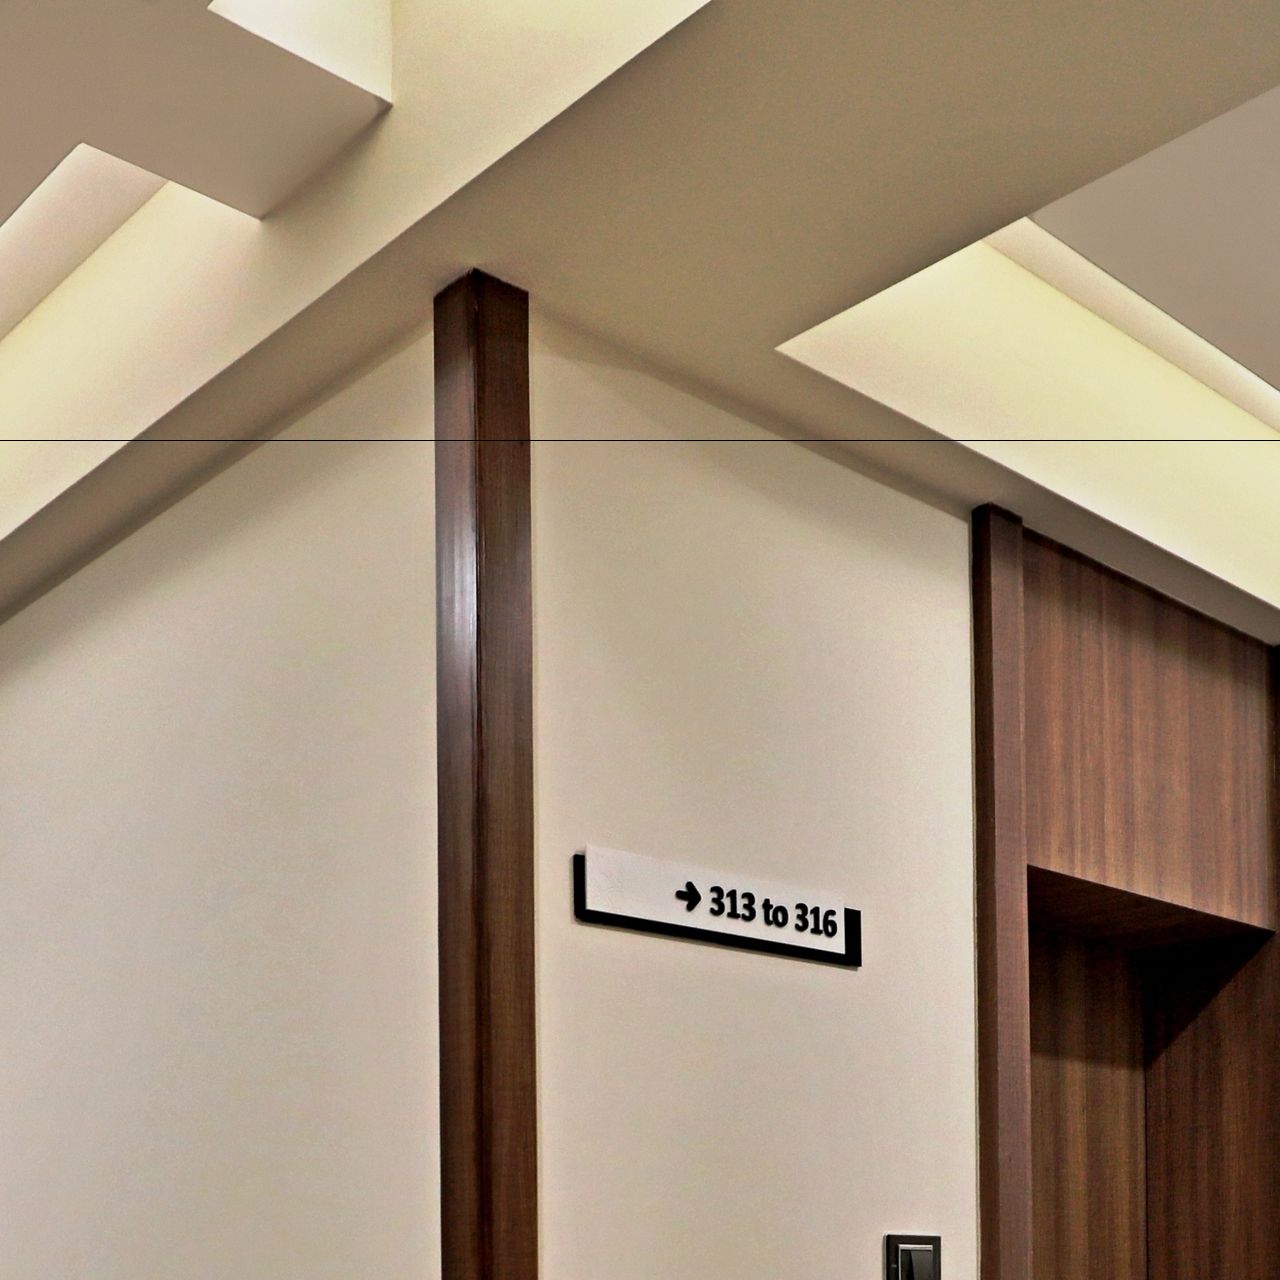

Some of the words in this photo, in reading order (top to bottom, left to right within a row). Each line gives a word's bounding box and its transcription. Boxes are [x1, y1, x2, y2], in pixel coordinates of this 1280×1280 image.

[709, 886, 757, 923] 313
[762, 898, 789, 928] to
[794, 902, 838, 938] 316
